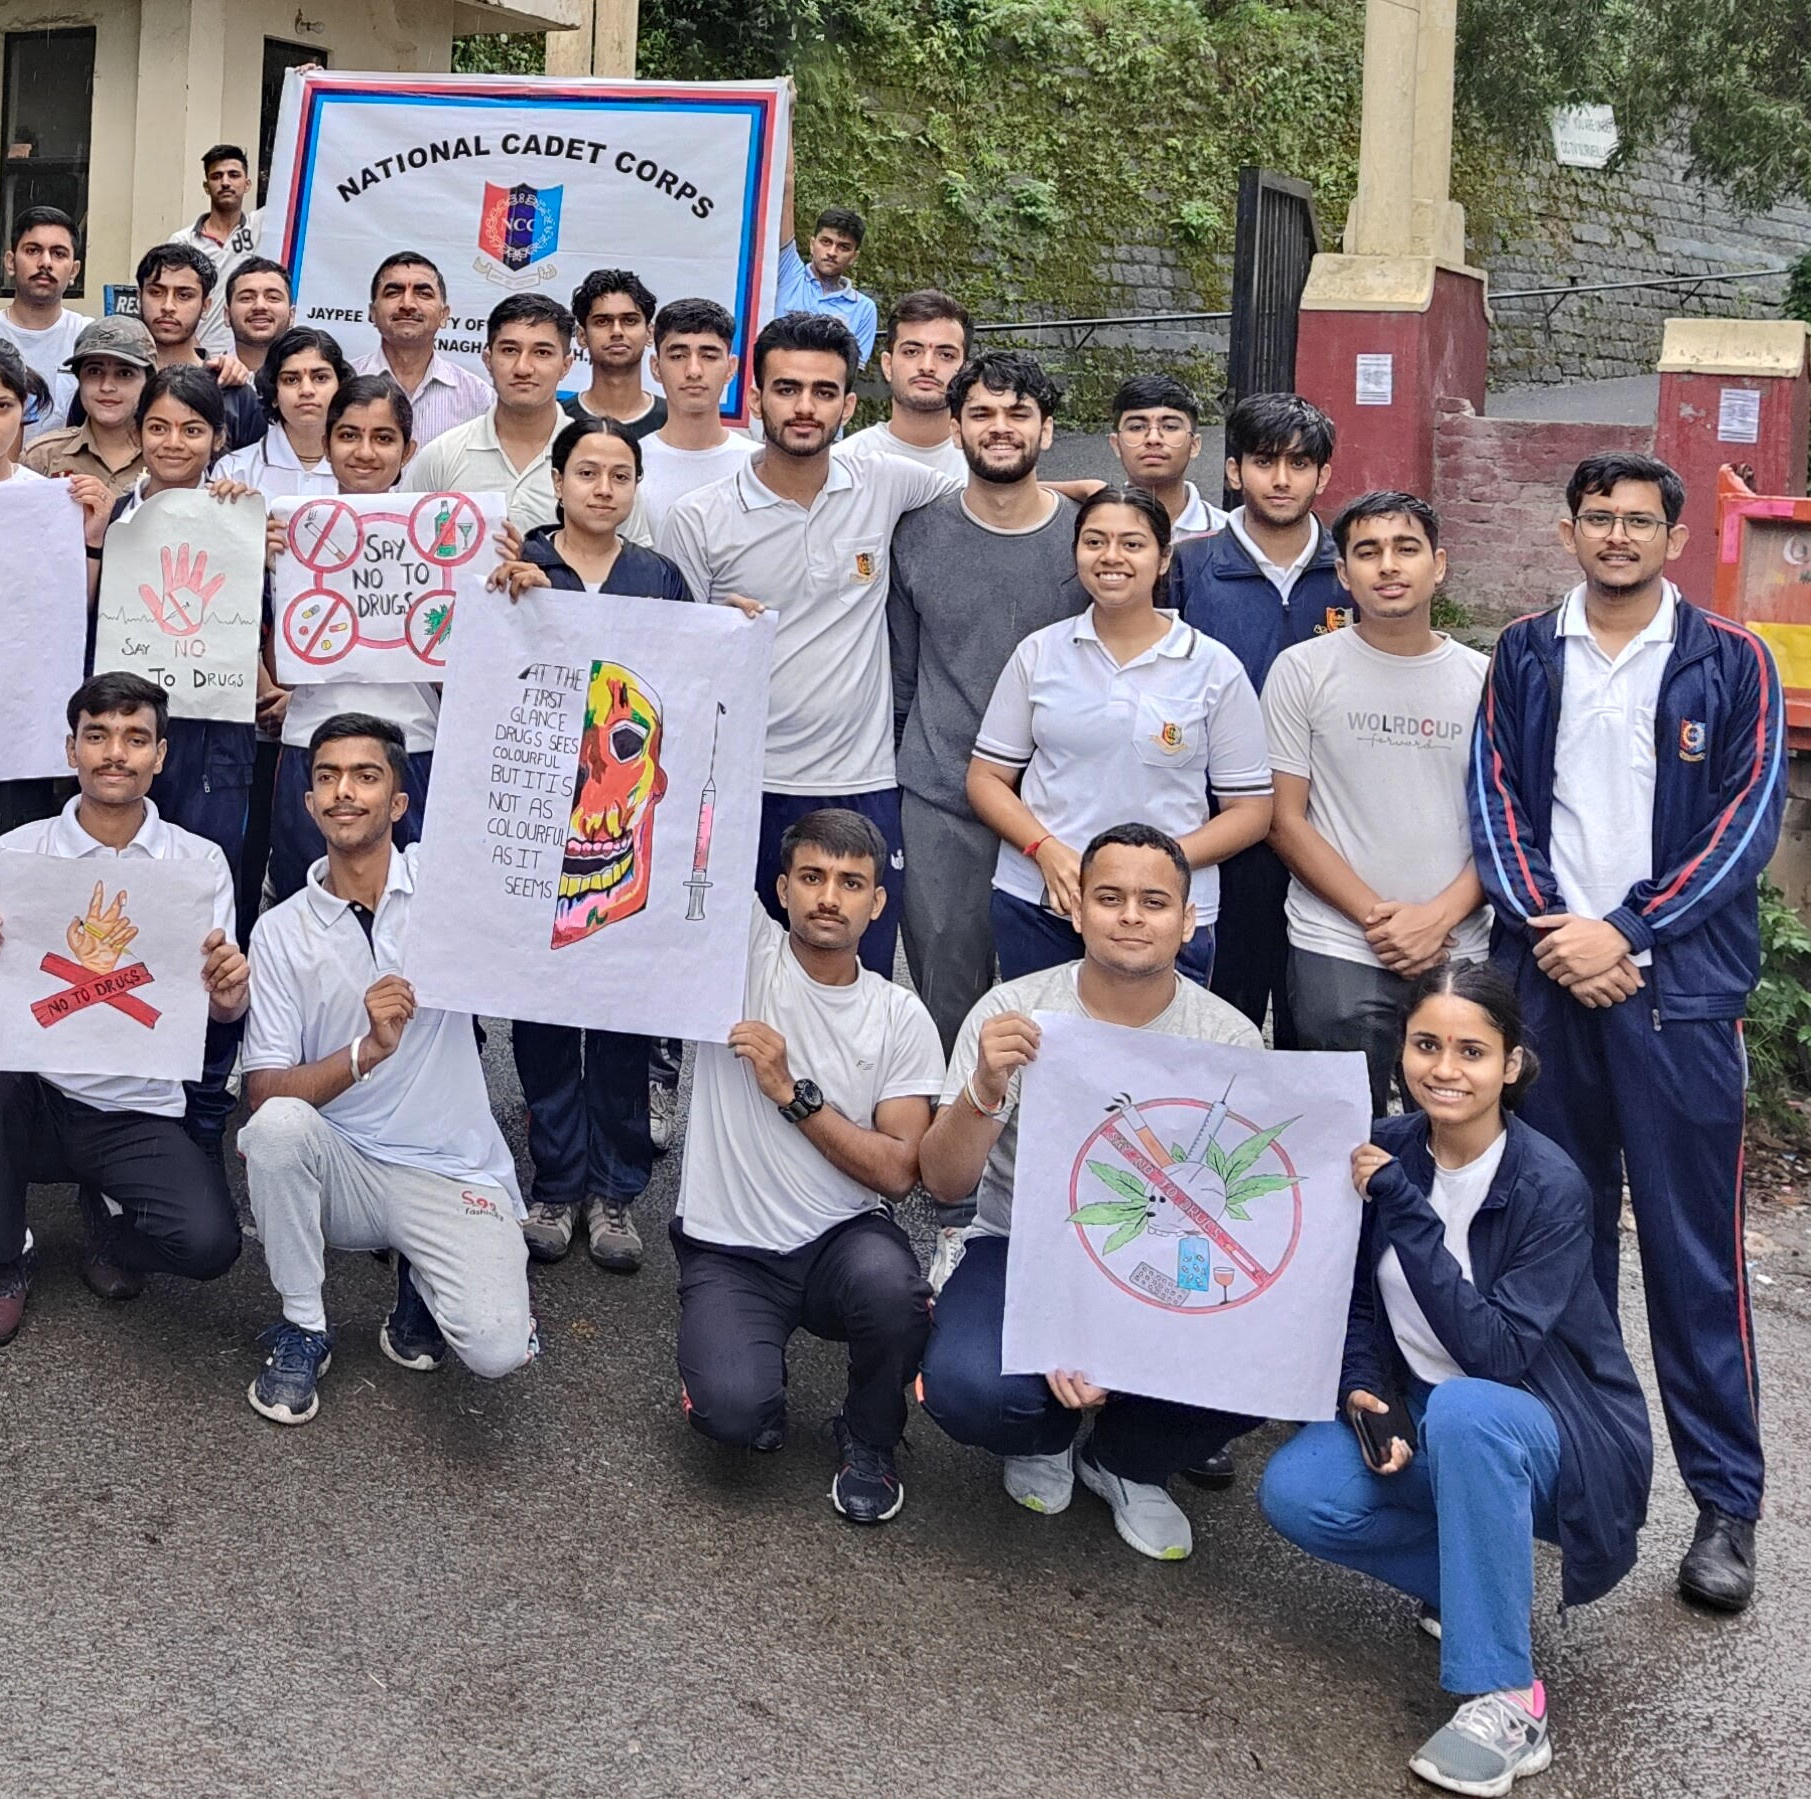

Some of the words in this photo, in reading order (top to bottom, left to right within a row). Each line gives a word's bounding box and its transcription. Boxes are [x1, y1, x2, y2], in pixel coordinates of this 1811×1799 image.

[336, 135, 490, 203] NATIONAL
[500, 133, 607, 165] CADET
[614, 150, 715, 221] CORPS
[307, 307, 364, 323] JAYPEE
[465, 319, 485, 331] OF
[364, 533, 406, 562] SAY
[352, 568, 383, 589] NO
[400, 562, 430, 585] TO
[357, 592, 414, 618] DRUGS
[121, 638, 151, 656] SAY
[174, 639, 206, 657] NO
[148, 668, 176, 687] TO
[193, 669, 245, 688] DRUGS
[518, 663, 551, 682] AT
[553, 665, 586, 691] THE
[523, 688, 566, 709] FIRST
[510, 706, 567, 732] GLANCE
[1347, 712, 1463, 741] WOLRDCUP
[495, 724, 542, 747] DRUGS
[548, 734, 579, 754] SEES
[492, 746, 561, 769] COLOURFUL
[491, 764, 521, 784] BUT
[522, 770, 546, 789] IT
[545, 773, 573, 797] IS
[488, 791, 521, 813] NOT
[529, 798, 553, 819] AS
[487, 818, 565, 847] COLOURFUL
[492, 845, 513, 866] AS
[516, 849, 542, 869] IT
[504, 876, 554, 899] SEEMS
[48, 997, 69, 1017] NO
[71, 989, 91, 1005] TO
[96, 969, 141, 996] DRUGS
